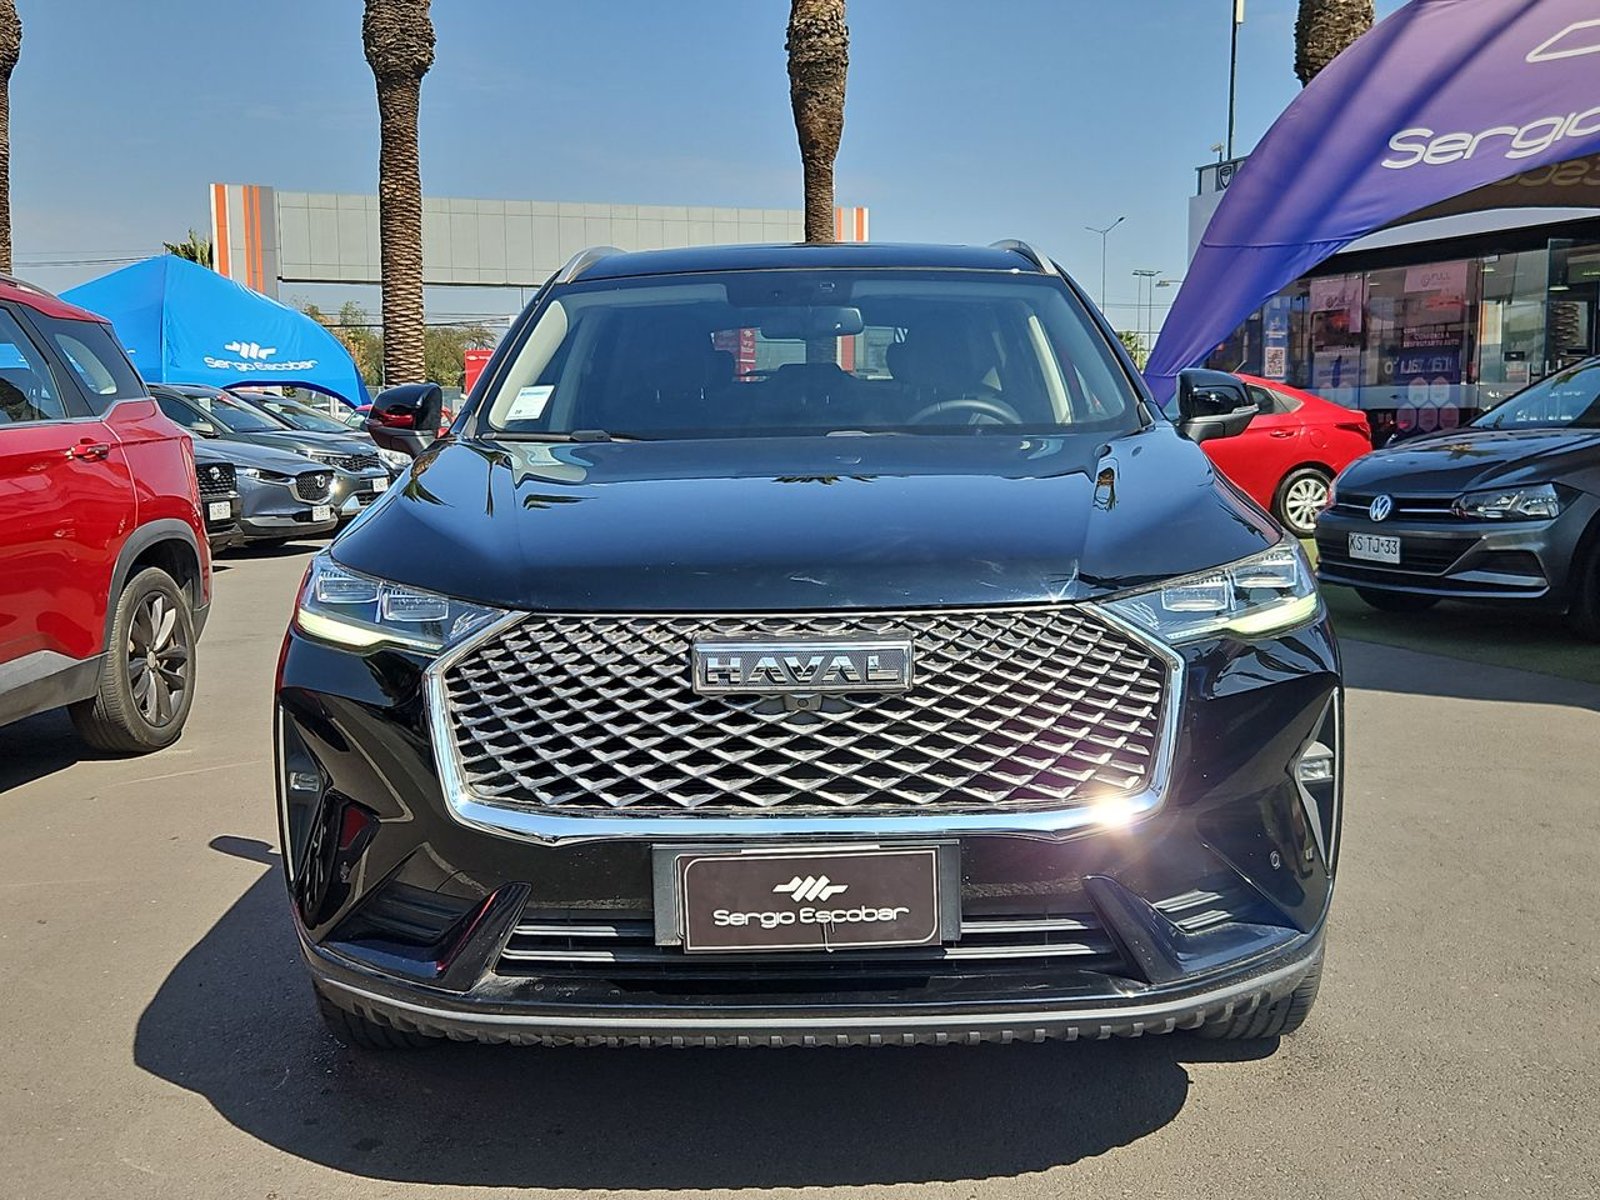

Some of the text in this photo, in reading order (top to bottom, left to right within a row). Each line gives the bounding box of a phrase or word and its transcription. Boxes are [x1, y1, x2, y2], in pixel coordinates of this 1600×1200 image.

[203, 356, 319, 372] Sergio Escobar
[705, 655, 899, 683] HAVAL
[713, 905, 910, 929] Sergio Escobar
